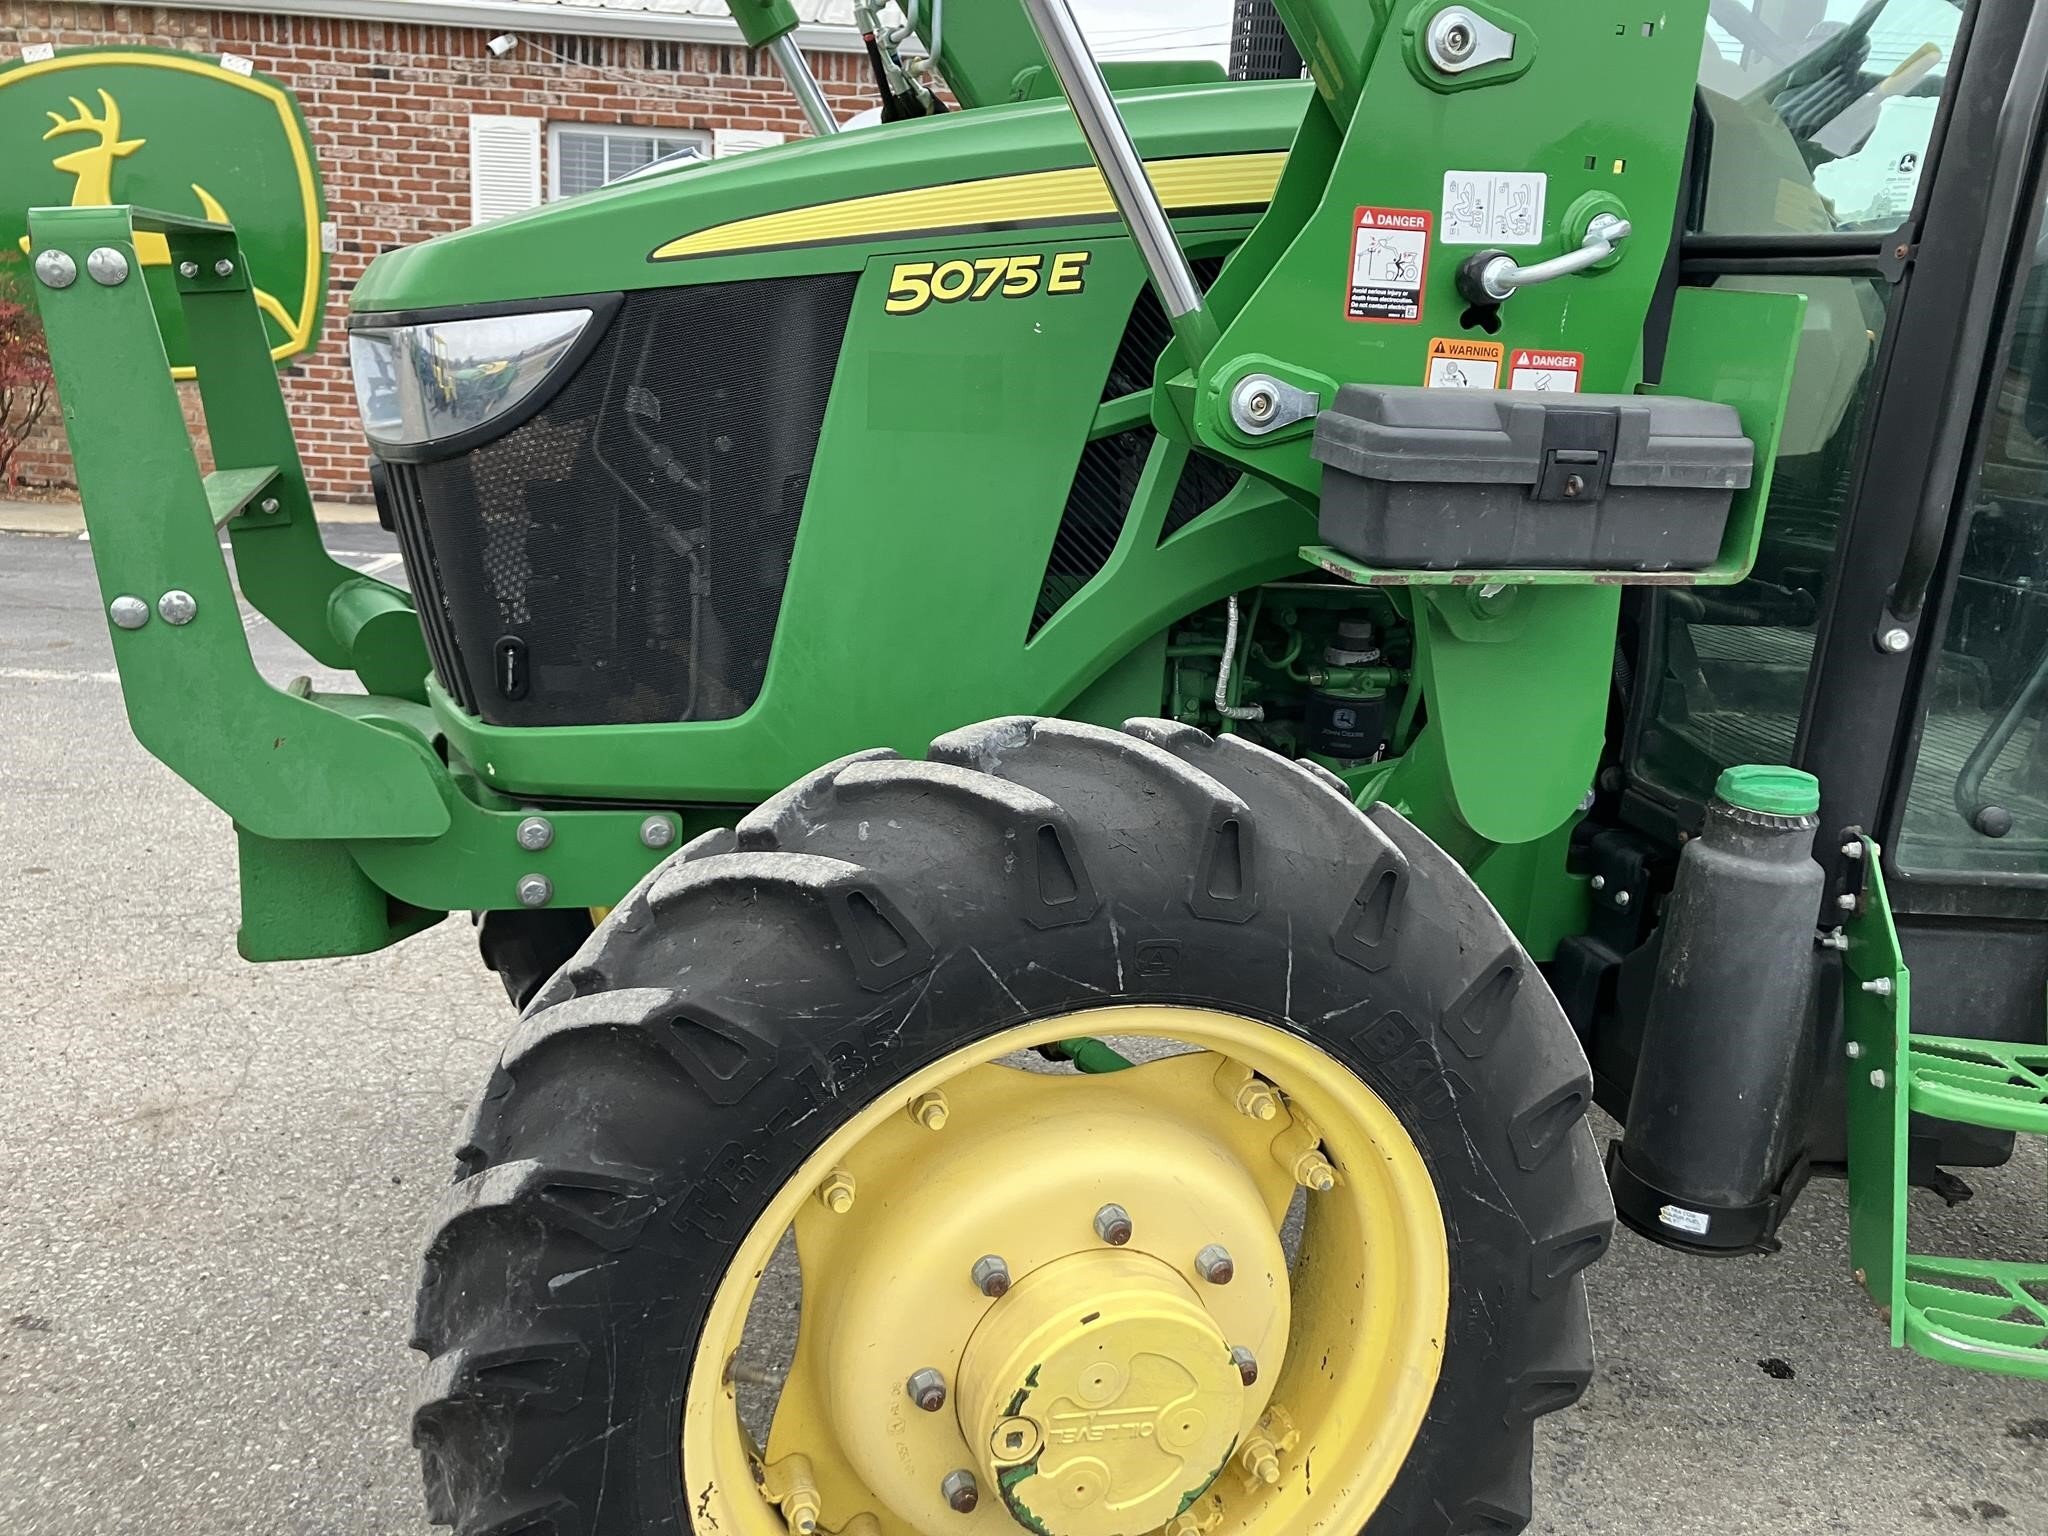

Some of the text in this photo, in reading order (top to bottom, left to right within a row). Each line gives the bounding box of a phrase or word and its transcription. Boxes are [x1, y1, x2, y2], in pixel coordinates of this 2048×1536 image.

[1377, 214, 1425, 228] DANGER
[1387, 289, 1402, 297] injury
[1449, 344, 1499, 358] WARNING
[1532, 355, 1577, 367] DANGER
